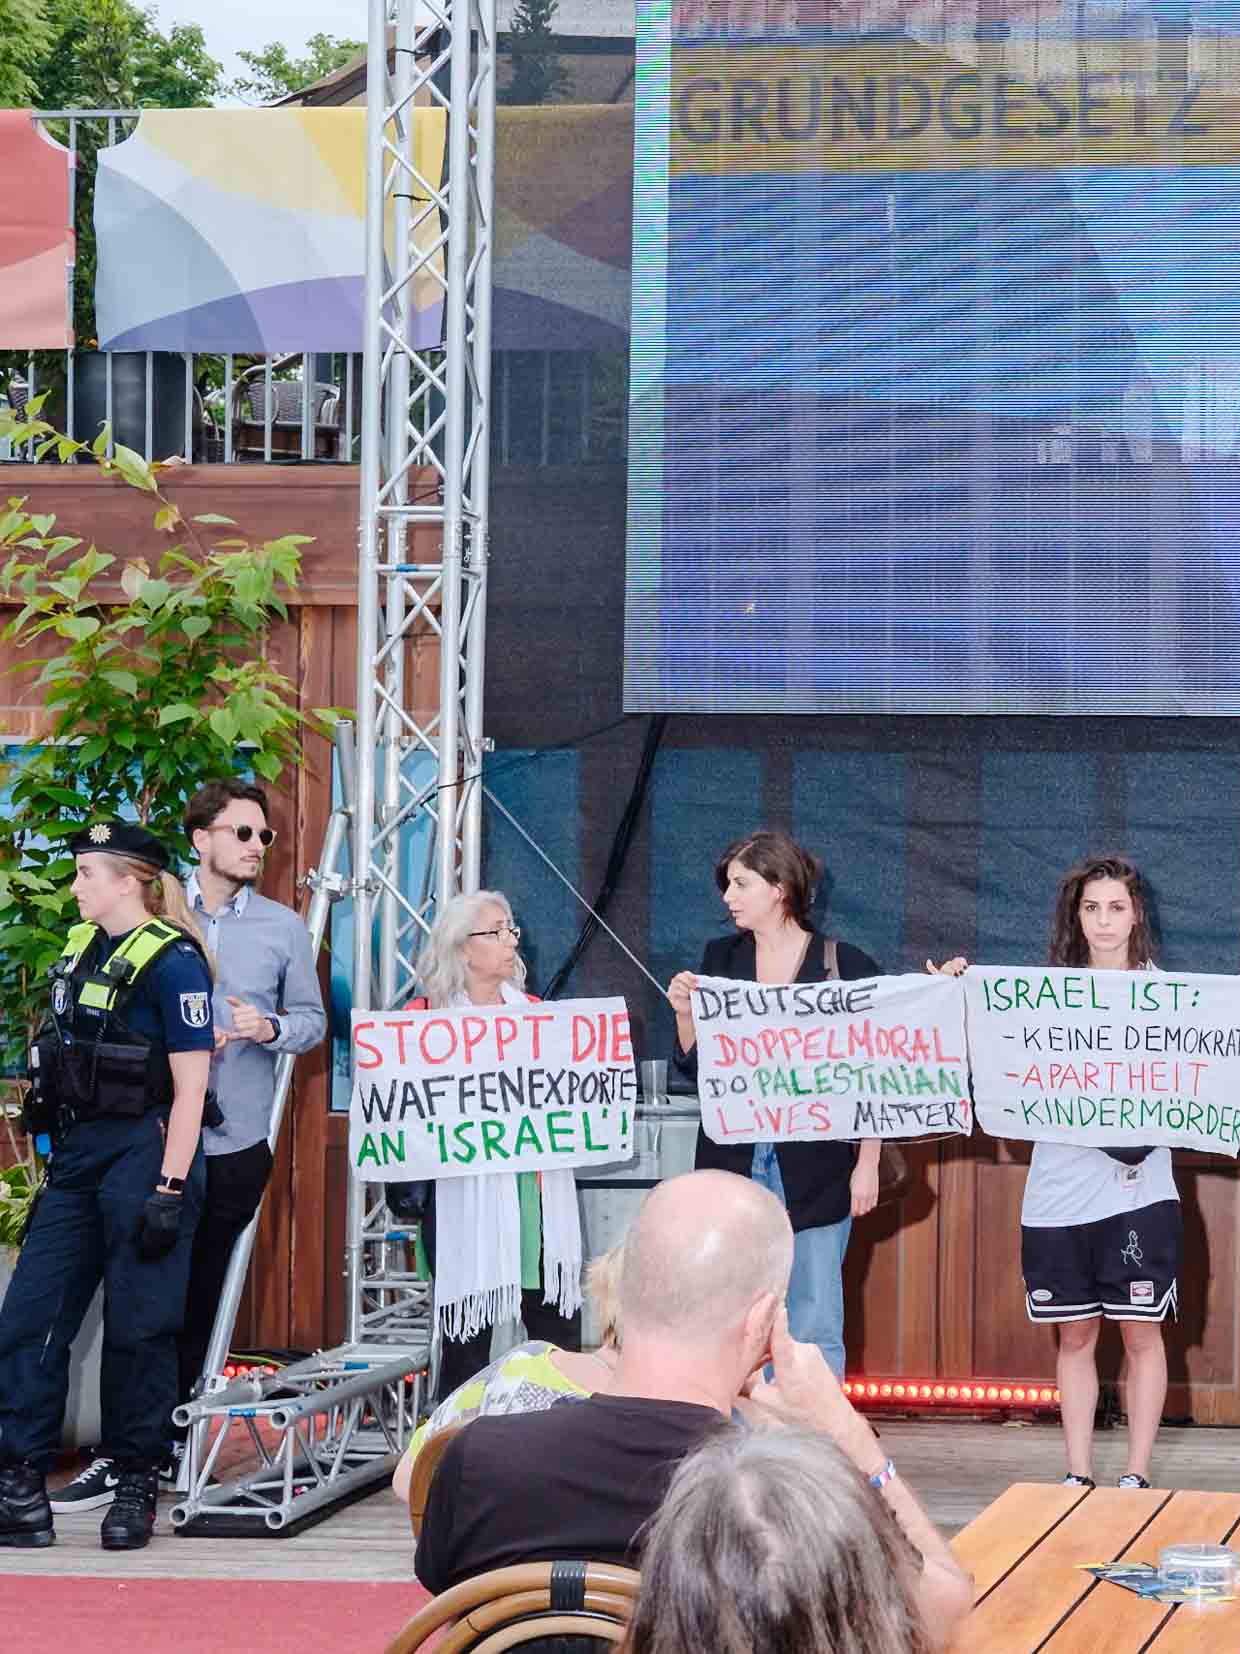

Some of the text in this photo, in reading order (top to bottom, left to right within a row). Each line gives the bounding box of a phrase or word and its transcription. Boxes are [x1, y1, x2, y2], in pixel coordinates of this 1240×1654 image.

[677, 70, 1212, 144] GRUNDGESETZ
[699, 984, 878, 1020] DEUTSCHE
[984, 976, 1200, 1012] ISRAEL IST:
[352, 1012, 632, 1069] STOPPT DIE
[712, 1019, 960, 1067] DOPPELMORAL
[359, 1066, 637, 1124] WAFFENEXPORTE
[706, 1075, 747, 1098] DO
[357, 1131, 406, 1166] AN
